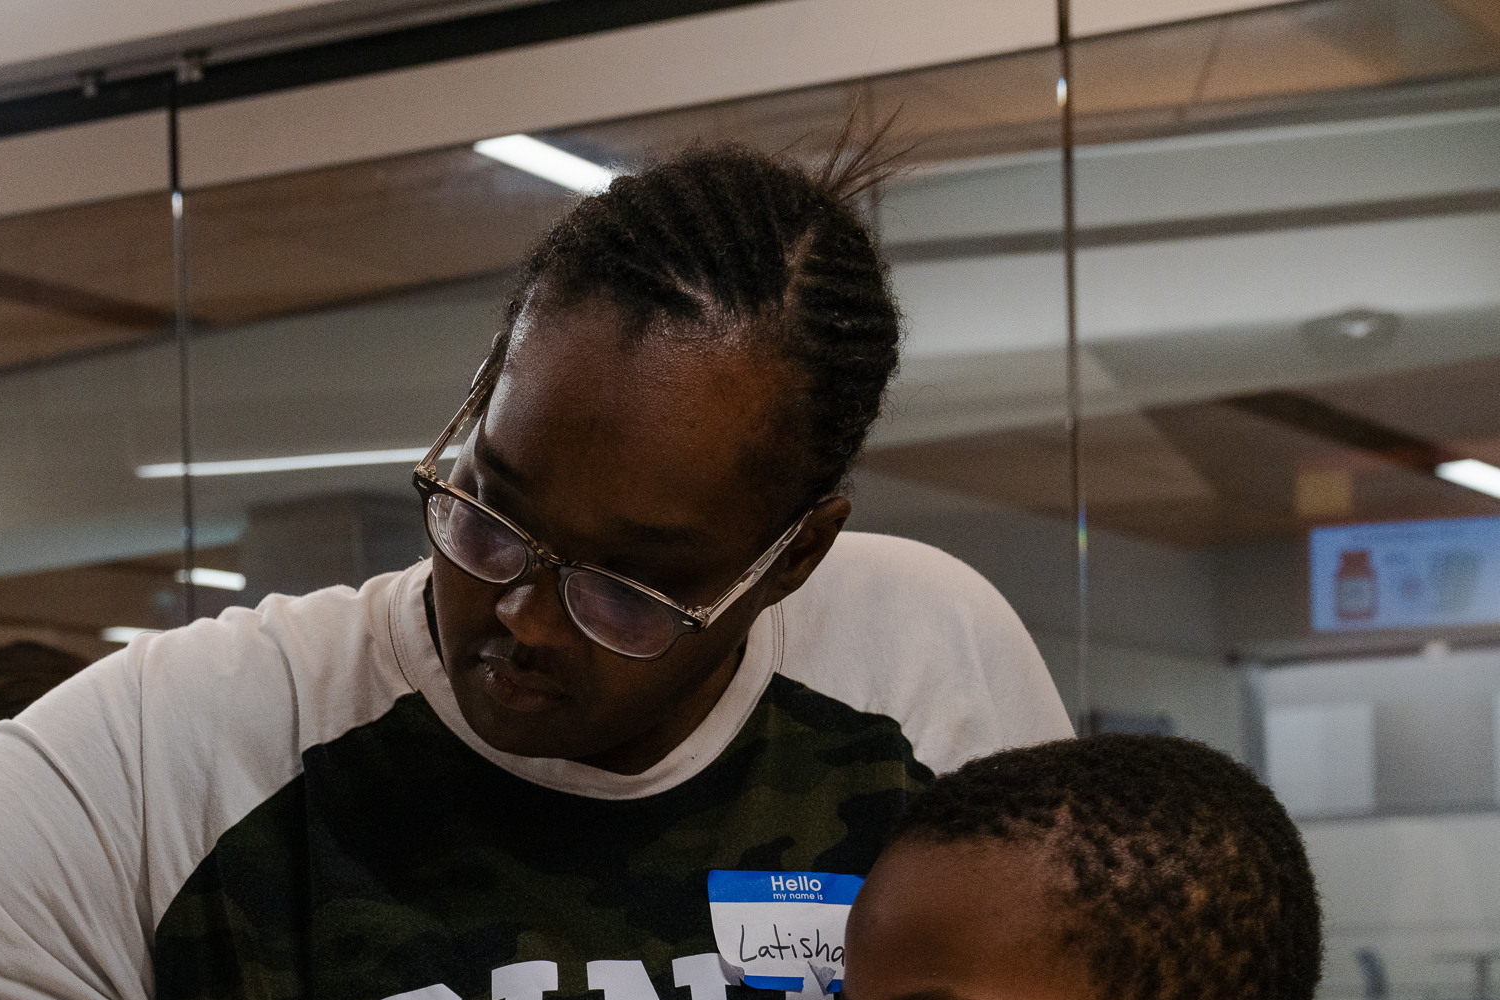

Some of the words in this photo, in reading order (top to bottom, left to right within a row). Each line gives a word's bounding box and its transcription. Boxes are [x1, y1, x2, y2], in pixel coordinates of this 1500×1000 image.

[771, 875, 822, 892] Hello
[773, 893, 787, 901] my
[789, 892, 815, 900] name
[817, 892, 824, 901] is
[739, 923, 845, 968] Latisha
